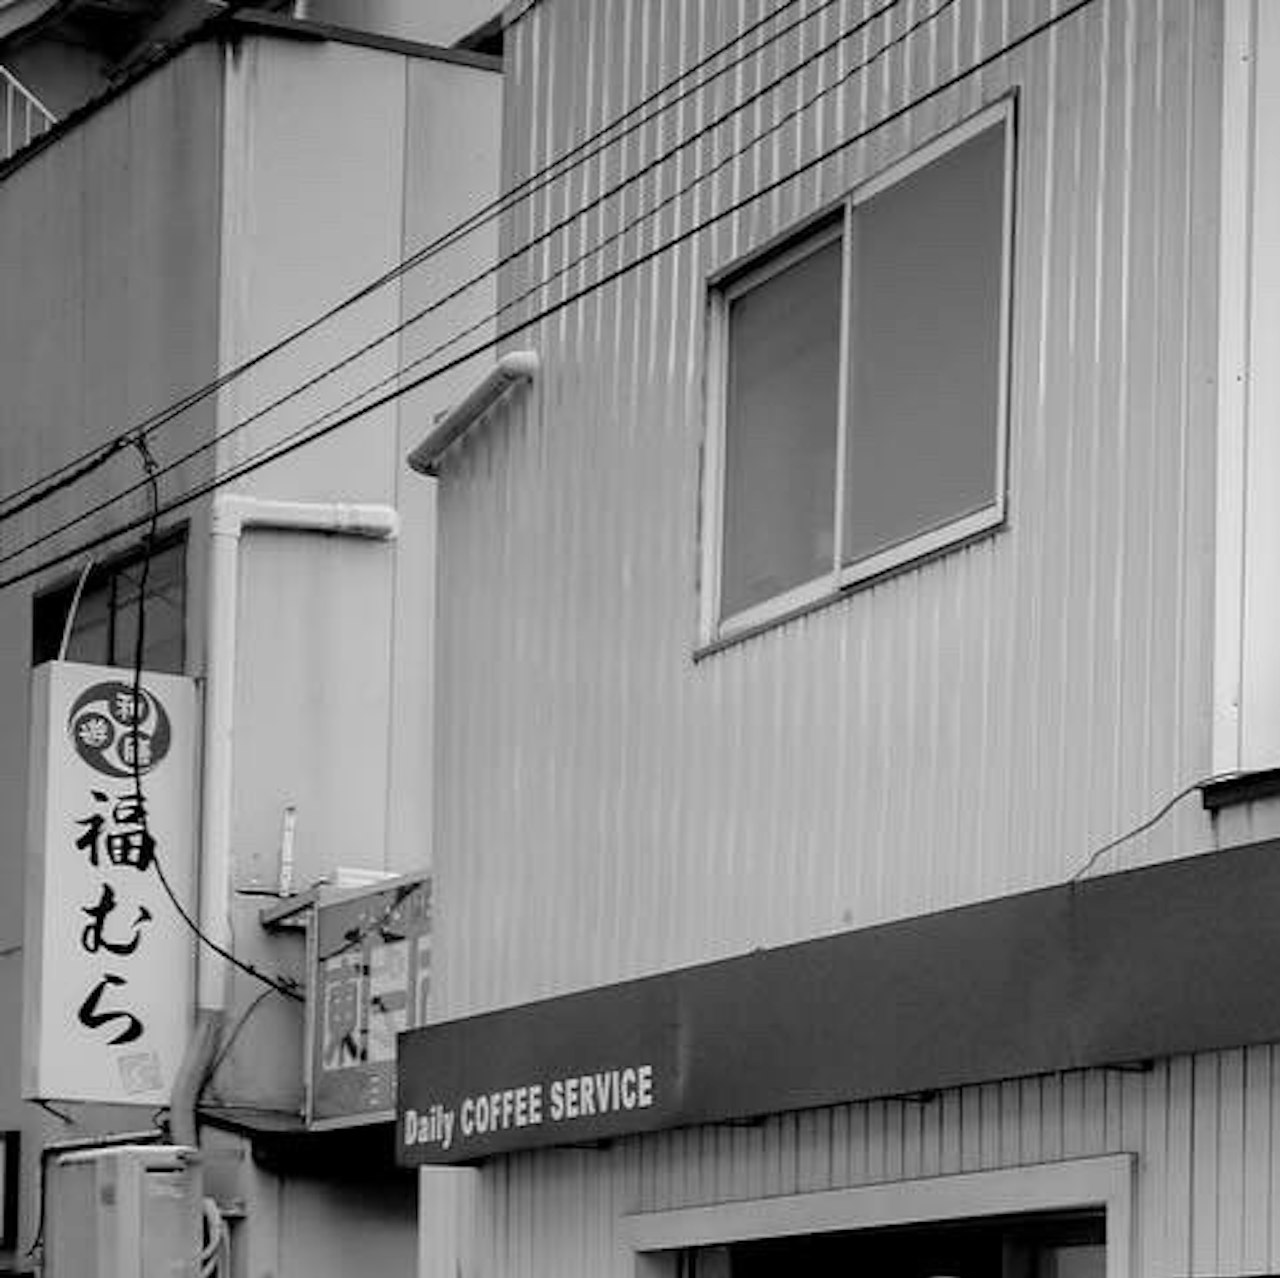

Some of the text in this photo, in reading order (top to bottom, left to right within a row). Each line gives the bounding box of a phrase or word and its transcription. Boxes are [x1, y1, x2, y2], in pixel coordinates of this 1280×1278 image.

[75, 790, 155, 1046] 福むら
[403, 1064, 654, 1151] Daily COFFEE SERVICE
